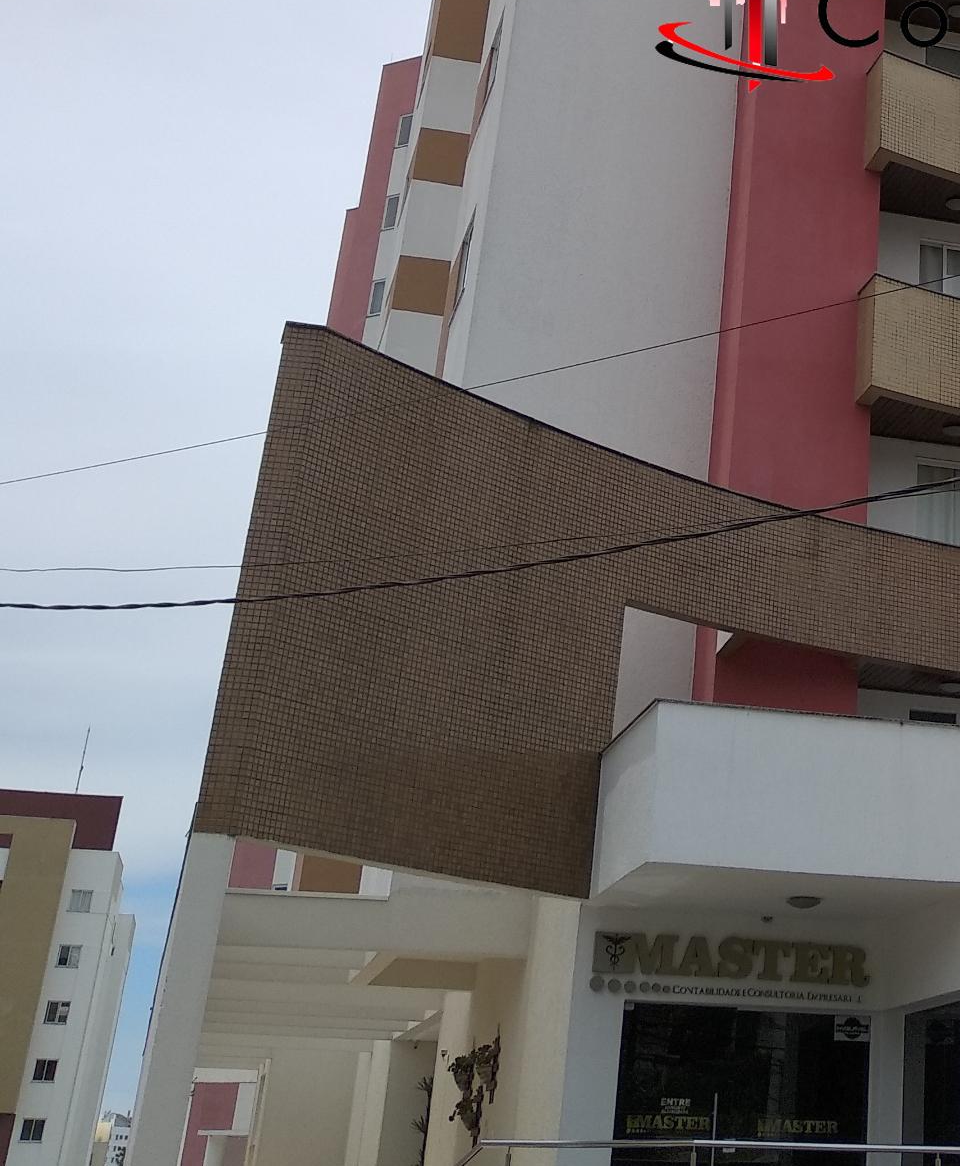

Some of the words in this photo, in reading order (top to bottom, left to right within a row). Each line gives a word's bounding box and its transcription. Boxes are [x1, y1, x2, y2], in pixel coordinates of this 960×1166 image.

[630, 933, 871, 987] MASTER
[807, 991, 862, 1003] EMPRESARIL
[638, 1114, 711, 1132] MASTER
